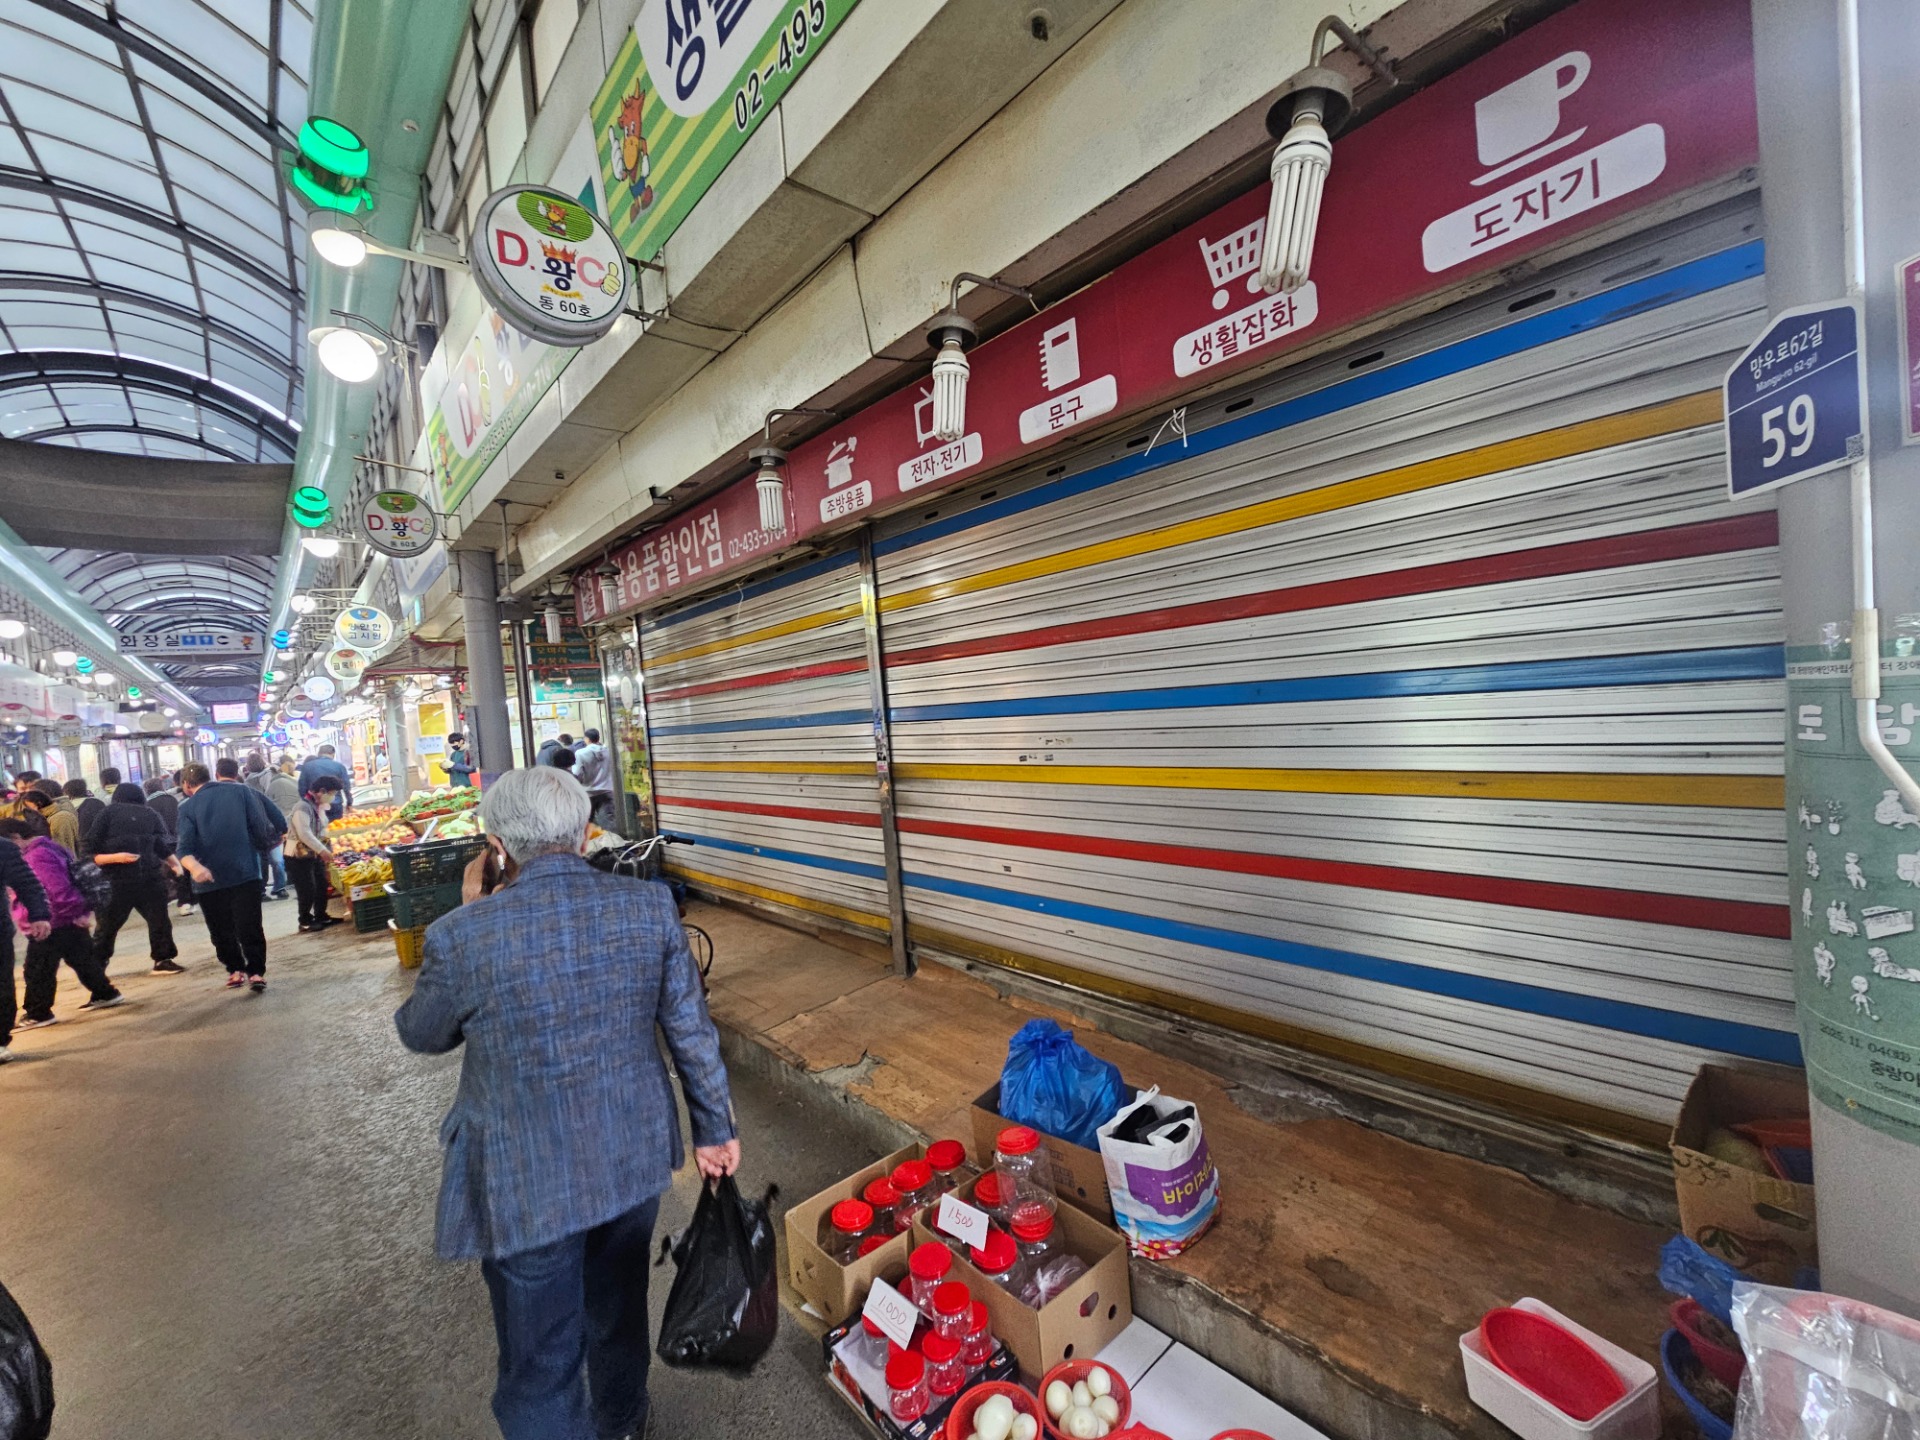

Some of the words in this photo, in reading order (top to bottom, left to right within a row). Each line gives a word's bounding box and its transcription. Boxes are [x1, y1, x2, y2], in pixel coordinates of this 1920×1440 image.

[1470, 157, 1600, 247] 도자기
[1190, 295, 1298, 366] 생활잡화
[1750, 319, 1824, 380] 망우로62길
[1794, 352, 1818, 376] 62-gil
[1047, 396, 1085, 431] 문구
[1761, 393, 1816, 468] 59
[826, 486, 865, 517] 주방용품
[120, 634, 181, 648] 화장실
